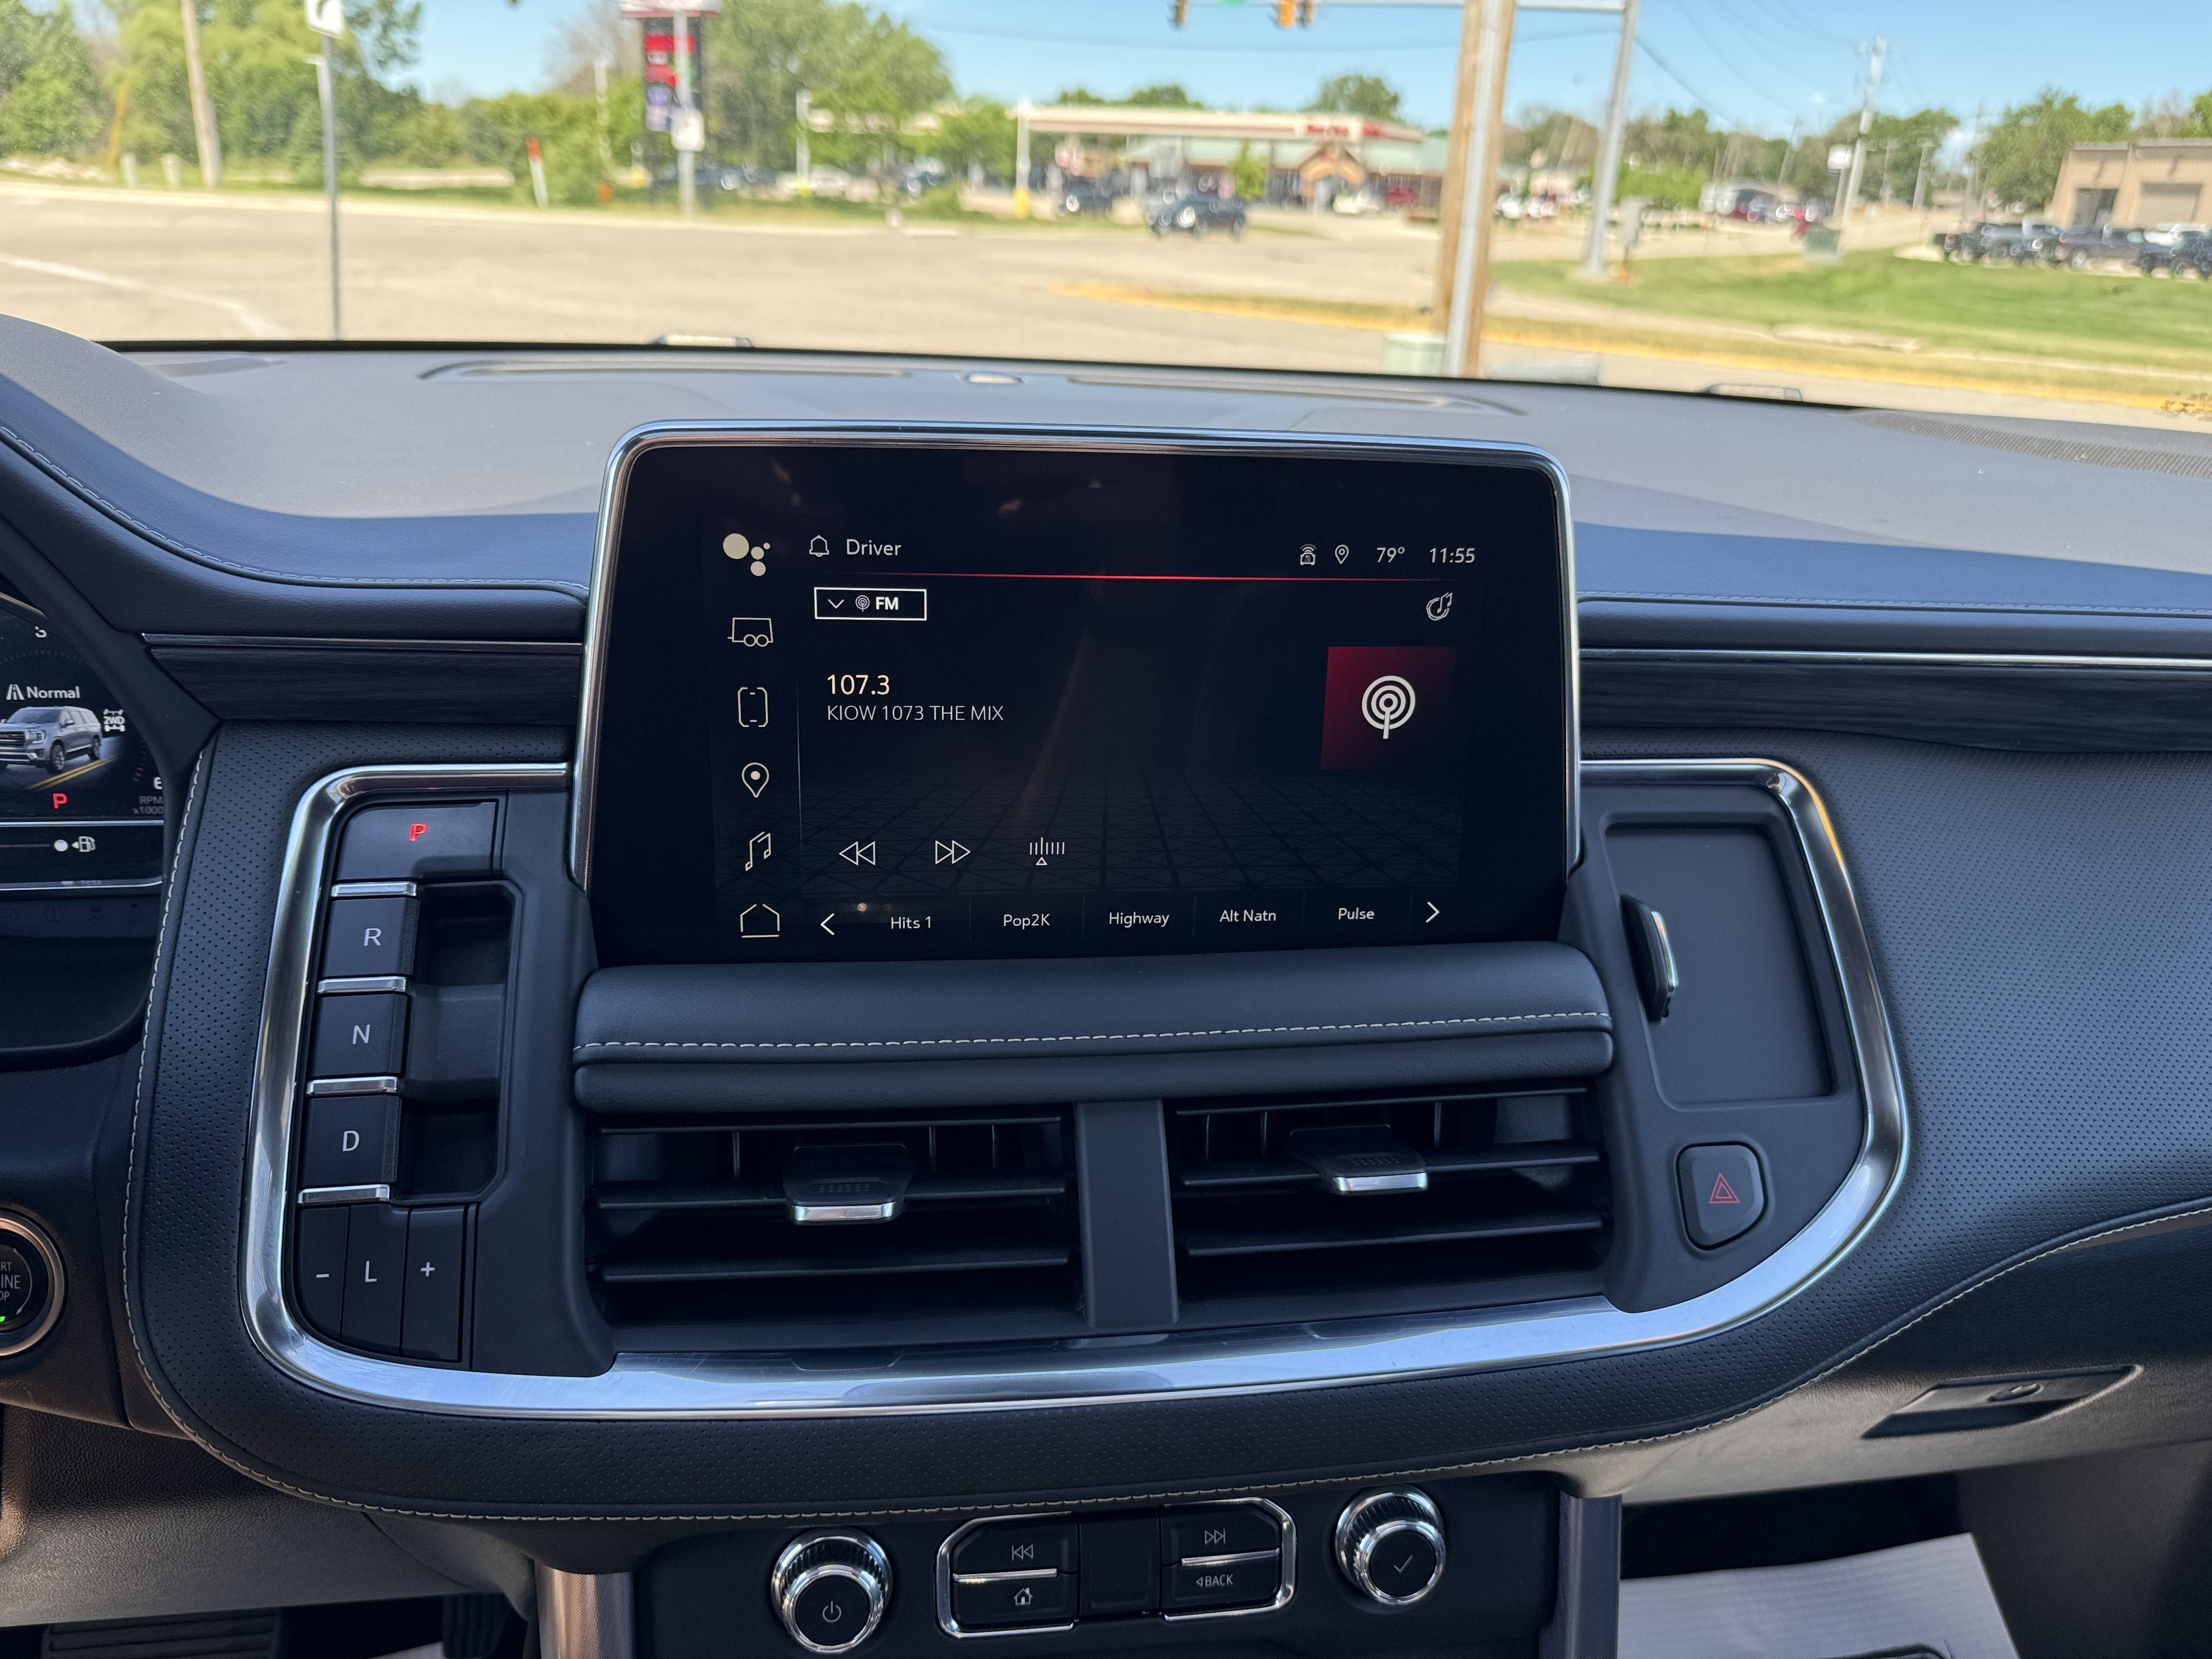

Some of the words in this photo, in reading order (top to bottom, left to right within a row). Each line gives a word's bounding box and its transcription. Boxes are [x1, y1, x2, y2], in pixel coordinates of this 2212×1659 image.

[847, 539, 901, 556] Driver
[1429, 548, 1475, 563] 11:55
[876, 596, 899, 611] FM
[827, 674, 890, 695] 107.3
[26, 686, 80, 699] Normal
[103, 715, 125, 725] 2WD
[827, 705, 877, 720] KIOW
[882, 705, 924, 720] 1073
[929, 705, 966, 720] THE
[971, 705, 1004, 720] MIX
[53, 793, 67, 809] P
[139, 795, 163, 805] RPM
[409, 822, 428, 842] P
[1003, 913, 1050, 930] Pop2K
[1109, 911, 1170, 928] Highway
[1219, 909, 1239, 922] Alt
[1243, 909, 1277, 922] Natn
[1338, 907, 1375, 921] Pulse
[890, 916, 921, 929] Hits
[925, 916, 932, 928] 1
[363, 928, 382, 946] R
[352, 1024, 371, 1045] N
[342, 1130, 360, 1152] D
[365, 1260, 377, 1283] L
[1205, 1573, 1234, 1587] BACK
